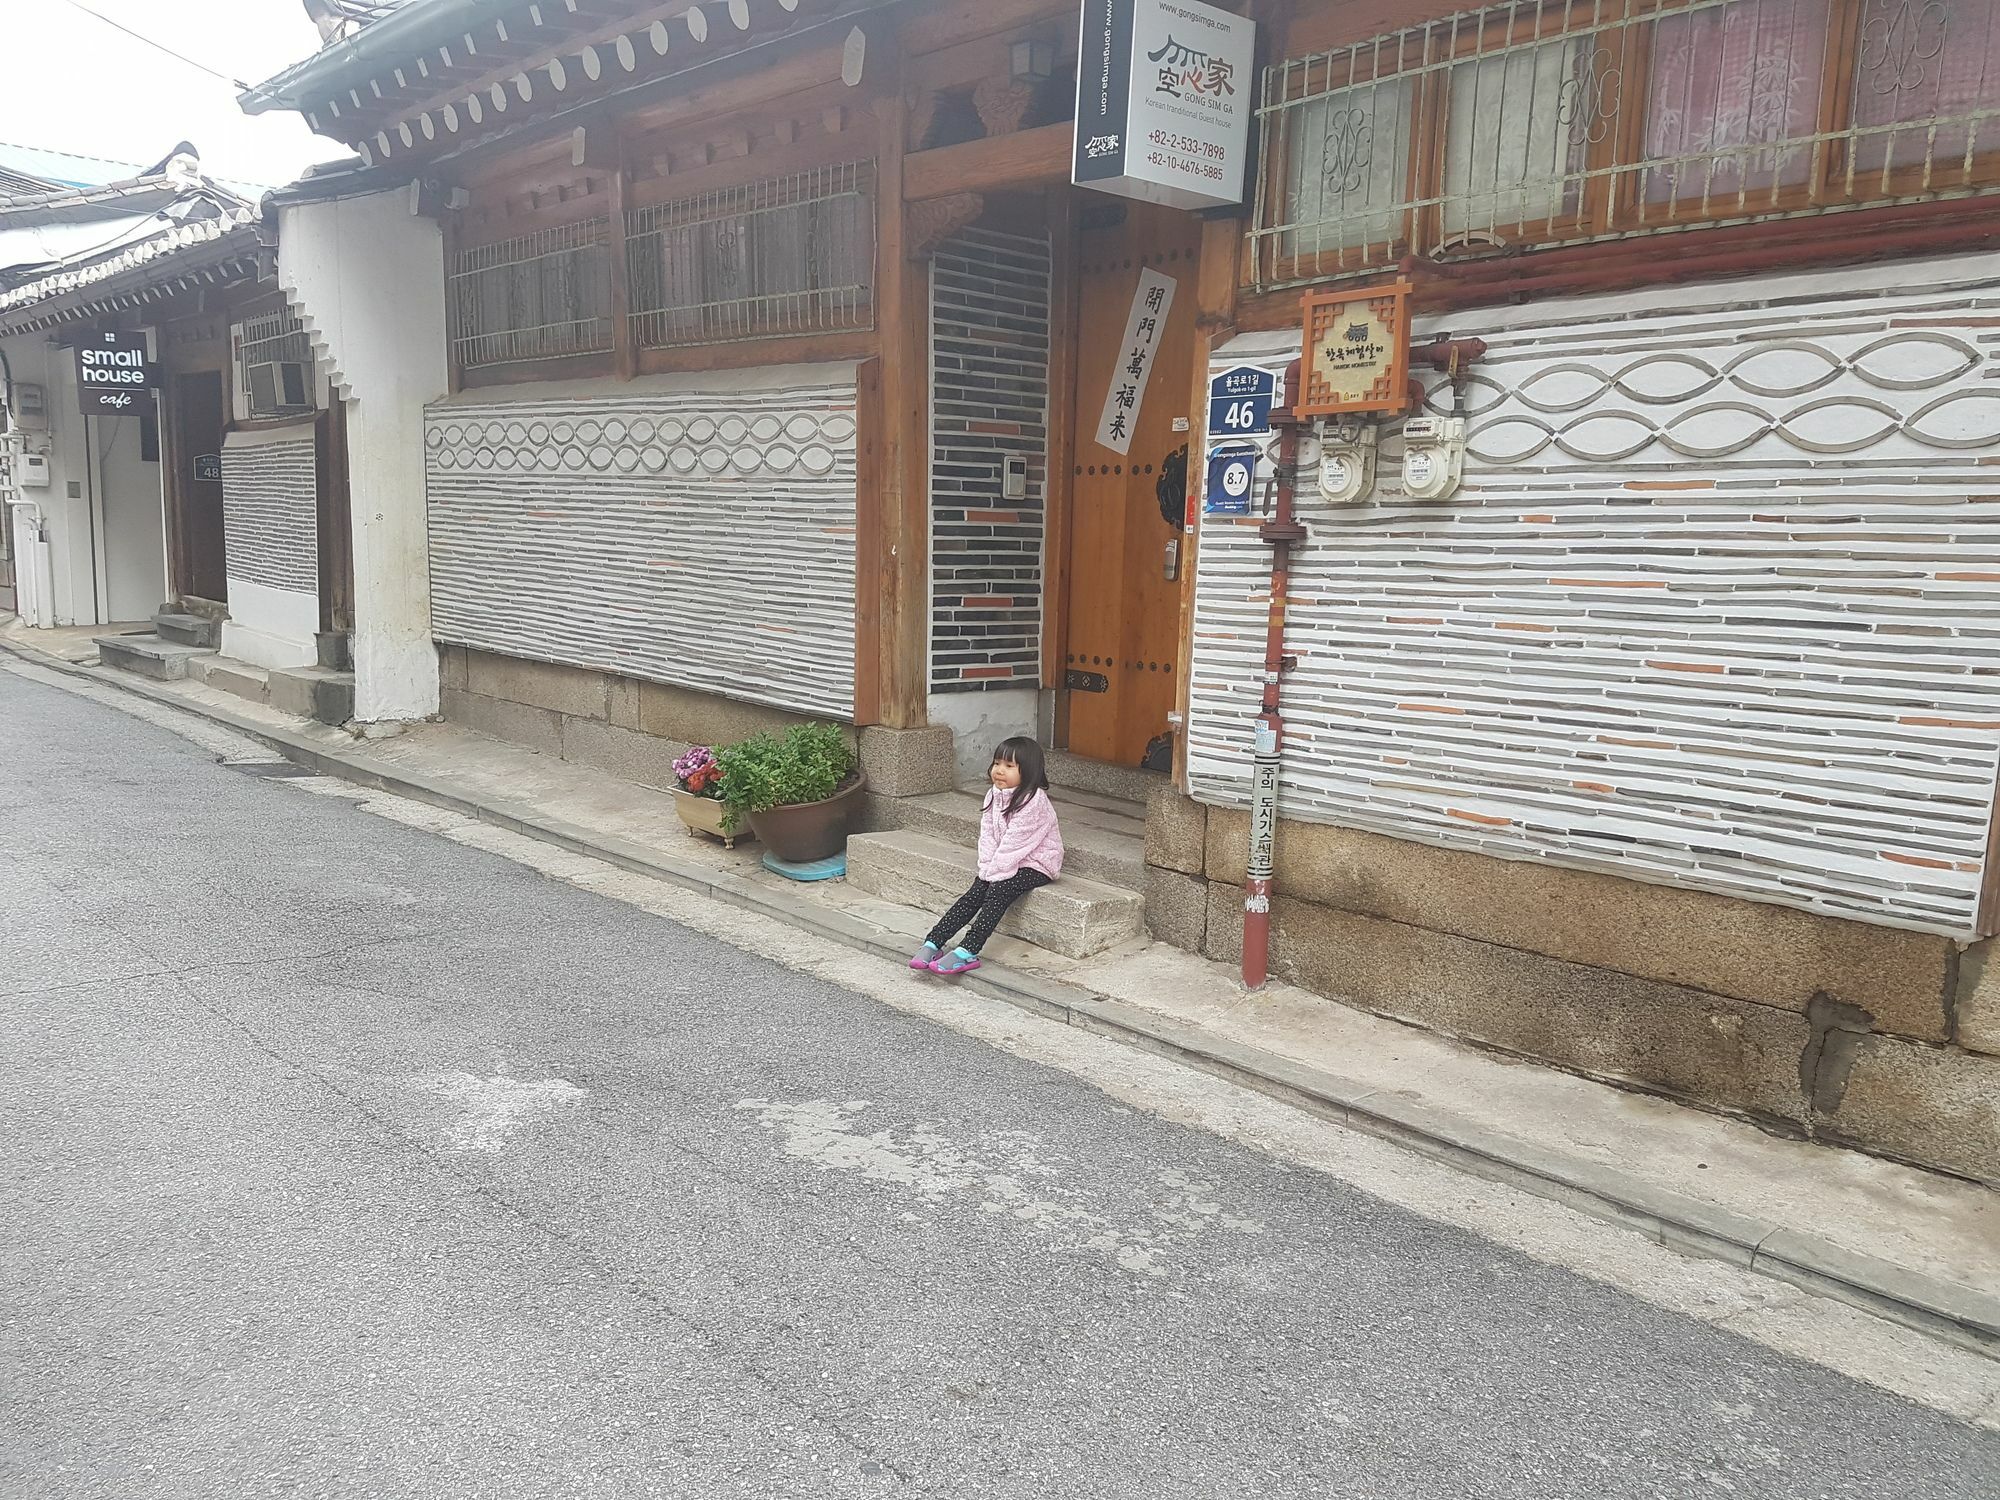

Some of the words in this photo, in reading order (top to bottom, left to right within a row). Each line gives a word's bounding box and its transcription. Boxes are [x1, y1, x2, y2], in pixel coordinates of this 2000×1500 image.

[1159, 2, 1232, 33] www.gongsimga.com
[1145, 96, 1166, 110] Korean
[1198, 112, 1215, 125] Guest
[1215, 117, 1232, 129] house
[1184, 92, 1206, 107] GONG
[1207, 99, 1221, 112] SIM
[1223, 104, 1234, 115] GA
[1148, 129, 1225, 161] +82-2-533-7898
[1147, 151, 1223, 181] +82-10-4676-5885
[81, 349, 143, 367] small
[82, 365, 145, 384] house
[1225, 374, 1259, 388] 율곡로1길
[100, 392, 132, 409] cafe
[1224, 401, 1254, 429] 46
[204, 467, 219, 478] 48
[1227, 471, 1245, 485] 8.7
[1260, 767, 1275, 790] 주의
